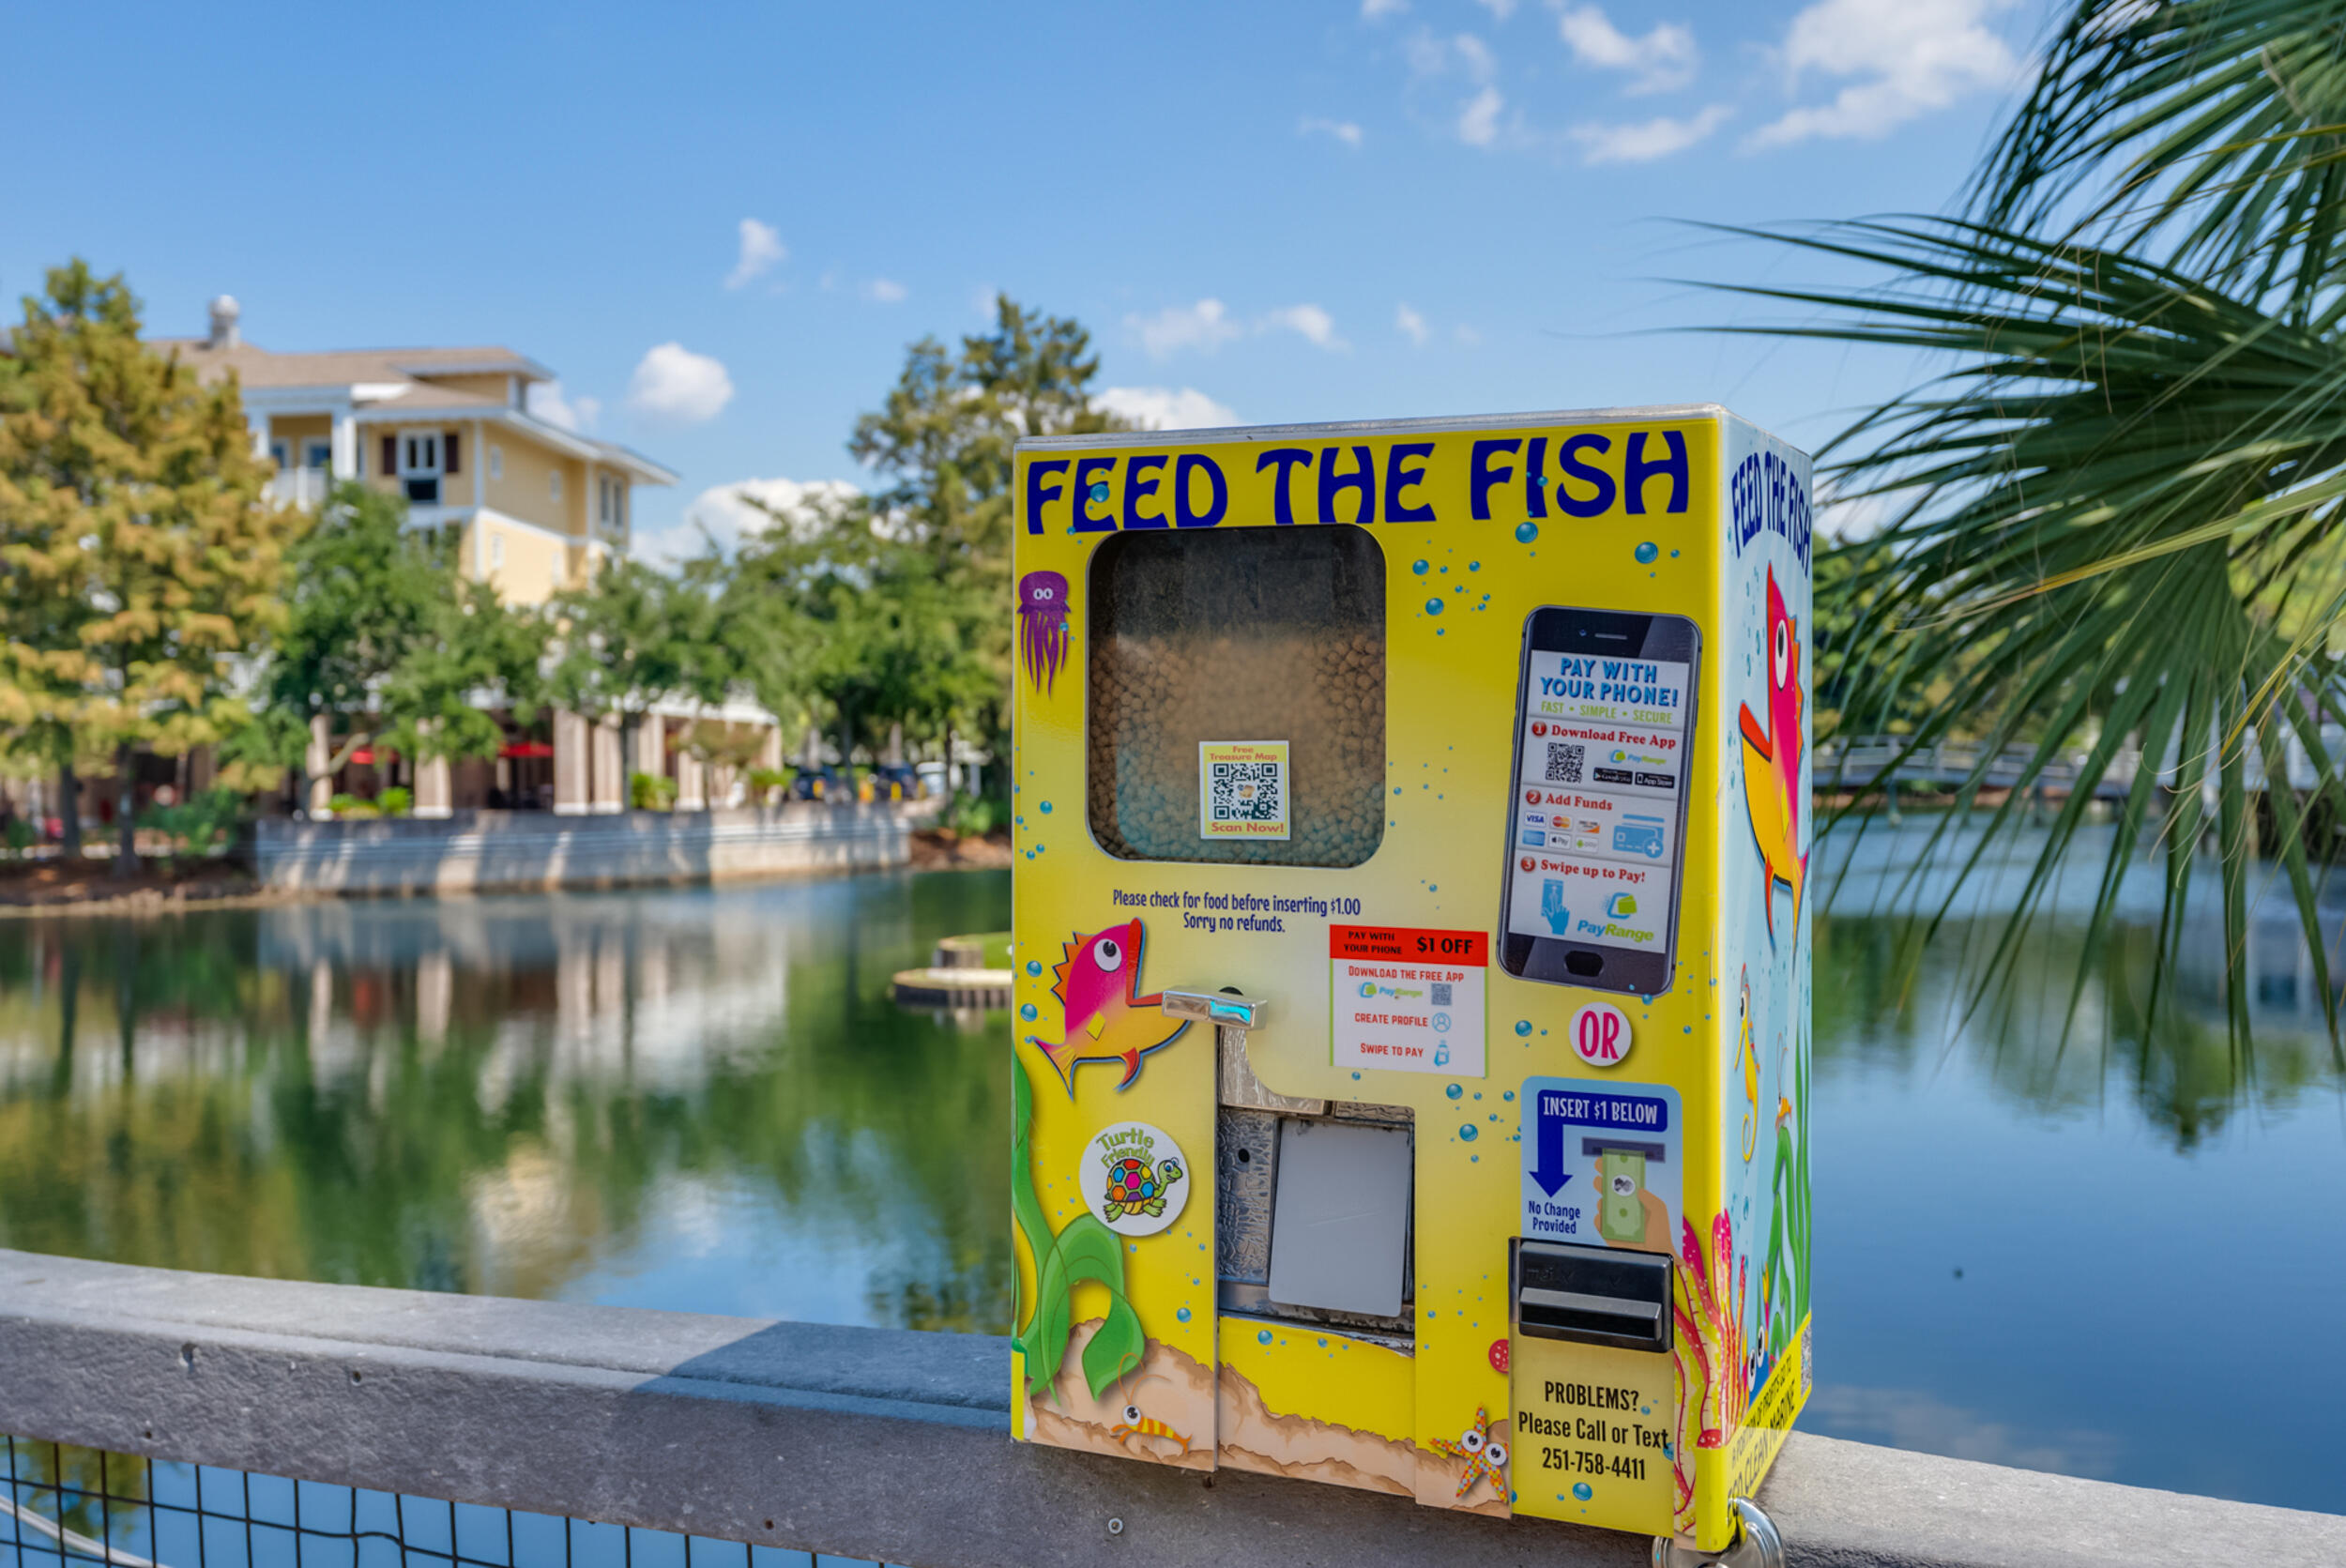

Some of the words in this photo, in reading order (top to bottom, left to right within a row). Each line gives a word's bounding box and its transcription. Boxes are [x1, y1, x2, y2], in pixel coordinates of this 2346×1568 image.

[1027, 453, 1227, 535] FEED
[1256, 443, 1437, 525] THE
[1470, 431, 1689, 520] FISH
[1731, 451, 1762, 559] FEED
[1764, 450, 1787, 539] THE
[1788, 470, 1812, 579] FISH
[1561, 657, 1596, 677] PAY
[1602, 661, 1658, 683] WITH
[1540, 677, 1594, 700] YOUR
[1600, 682, 1679, 707] PHONE!
[1541, 701, 1565, 714] FAST
[1579, 704, 1618, 719] SIMPLE
[1633, 709, 1672, 724] SECURE
[1551, 724, 1615, 741] Download
[1618, 732, 1646, 745] Free
[1649, 736, 1677, 750] App
[1210, 753, 1252, 761] Treasure
[1255, 753, 1278, 762] Map
[1546, 793, 1571, 807] Add
[1574, 797, 1613, 812] Funds
[1211, 822, 1242, 832] Scan
[1246, 822, 1285, 833] Now!
[1527, 814, 1545, 824] VISA
[1541, 859, 1579, 875] Swipe
[1582, 865, 1599, 878] up
[1602, 866, 1616, 878] to
[1619, 870, 1646, 884] Pay!
[1113, 889, 1148, 907] Please
[1150, 891, 1180, 908] check
[1182, 891, 1201, 909] for
[1204, 892, 1228, 910] food
[1231, 893, 1270, 912] before
[1272, 894, 1328, 917] inserting
[1331, 897, 1362, 916] $1.00
[1183, 911, 1216, 933] Sorry
[1219, 918, 1234, 930] no
[1237, 914, 1286, 933] refunds.
[1577, 920, 1654, 943] PayRange
[1348, 931, 1366, 939] PAY
[1369, 932, 1395, 941] WITH
[1416, 936, 1436, 953] $1
[1440, 937, 1473, 954] OFF
[1344, 944, 1368, 953] YOUR
[1371, 945, 1402, 954] PHONE
[1401, 968, 1417, 980] THE
[1419, 970, 1442, 982] FREE
[1354, 1012, 1389, 1025] CREATE
[1392, 1015, 1428, 1028] PROFILE
[1579, 1010, 1620, 1059] OR
[1392, 1045, 1403, 1057] TO
[1405, 1047, 1424, 1058] PAY
[1543, 1096, 1590, 1119] INSERT
[1594, 1101, 1607, 1120] $1
[1612, 1102, 1658, 1124] BELOW
[1095, 1127, 1155, 1151] Turtle
[1101, 1147, 1155, 1169] Friendly
[1529, 1200, 1541, 1215] No
[1544, 1201, 1581, 1220] Change
[1532, 1217, 1577, 1234] Provided
[1545, 1380, 1640, 1411] PROBLEMS?
[1518, 1410, 1571, 1439] Please
[1577, 1417, 1607, 1442] Call
[1611, 1426, 1628, 1444] or
[1633, 1424, 1669, 1450] Text
[1542, 1447, 1646, 1481] 251-758-4411
